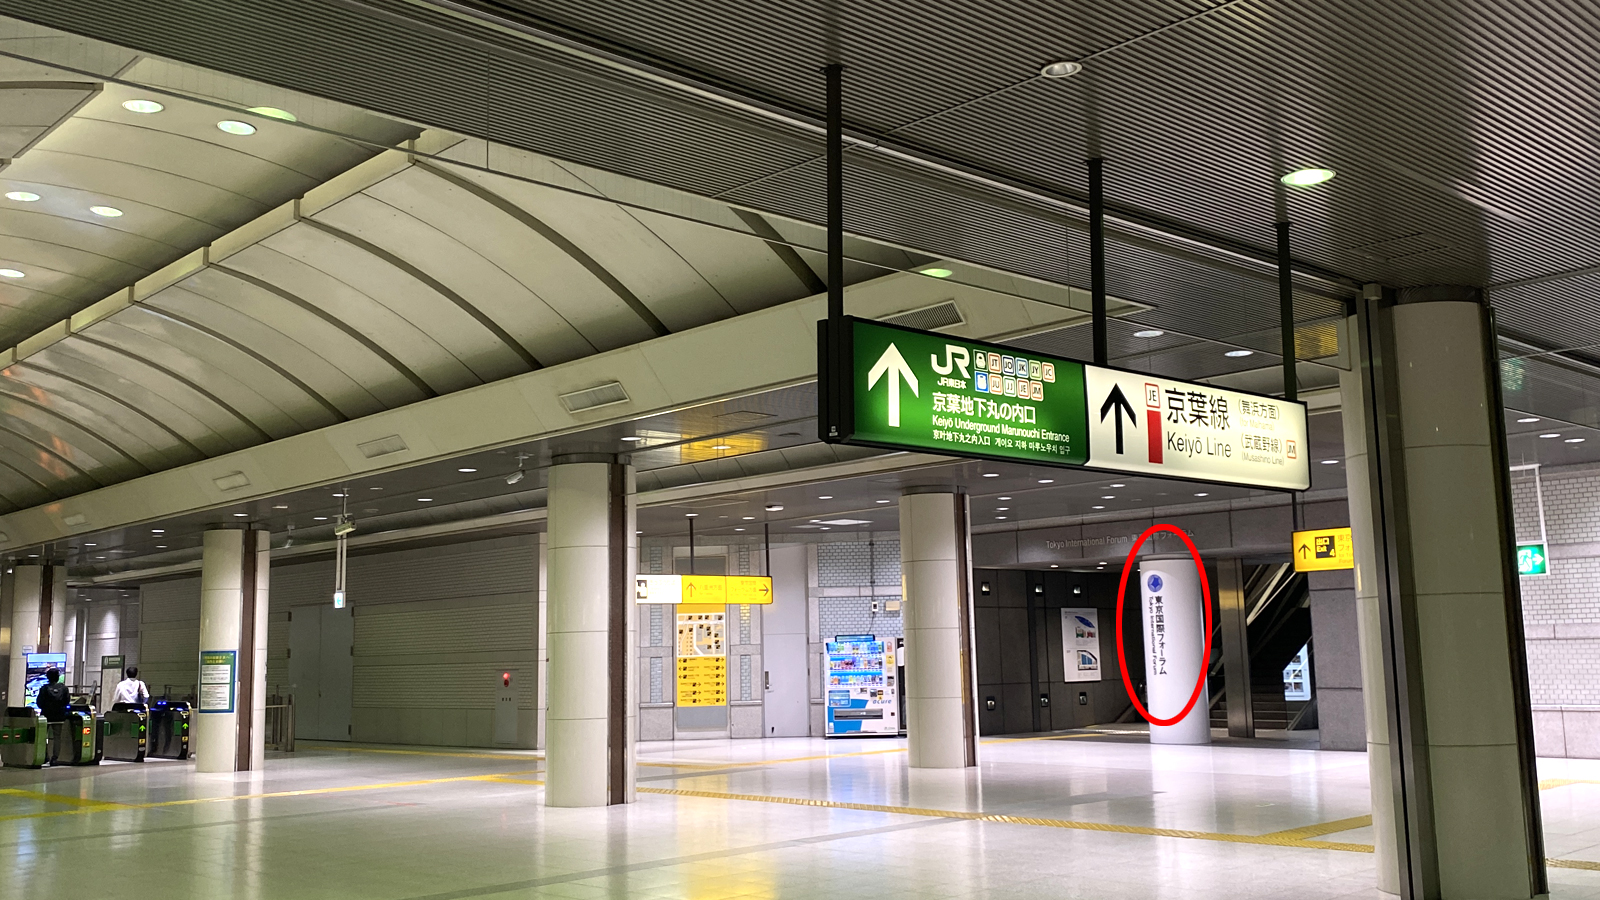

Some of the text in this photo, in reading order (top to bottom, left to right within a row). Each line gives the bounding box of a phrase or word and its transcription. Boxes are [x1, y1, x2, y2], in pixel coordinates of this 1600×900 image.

[931, 344, 971, 379] JR
[932, 391, 1036, 424] 京葉地下丸の内口
[1149, 390, 1157, 401] JE
[1165, 388, 1230, 430] 京葉線
[932, 414, 1070, 442] Keiyō Underground Marunouchi Entrance
[1015, 440, 1027, 450] 지하
[1167, 431, 1232, 458] Keiyō Line
[1046, 536, 1128, 550] Tokyo International Forum
[1330, 548, 1335, 556] 4
[1154, 596, 1167, 675] 東京国際フォーラム
